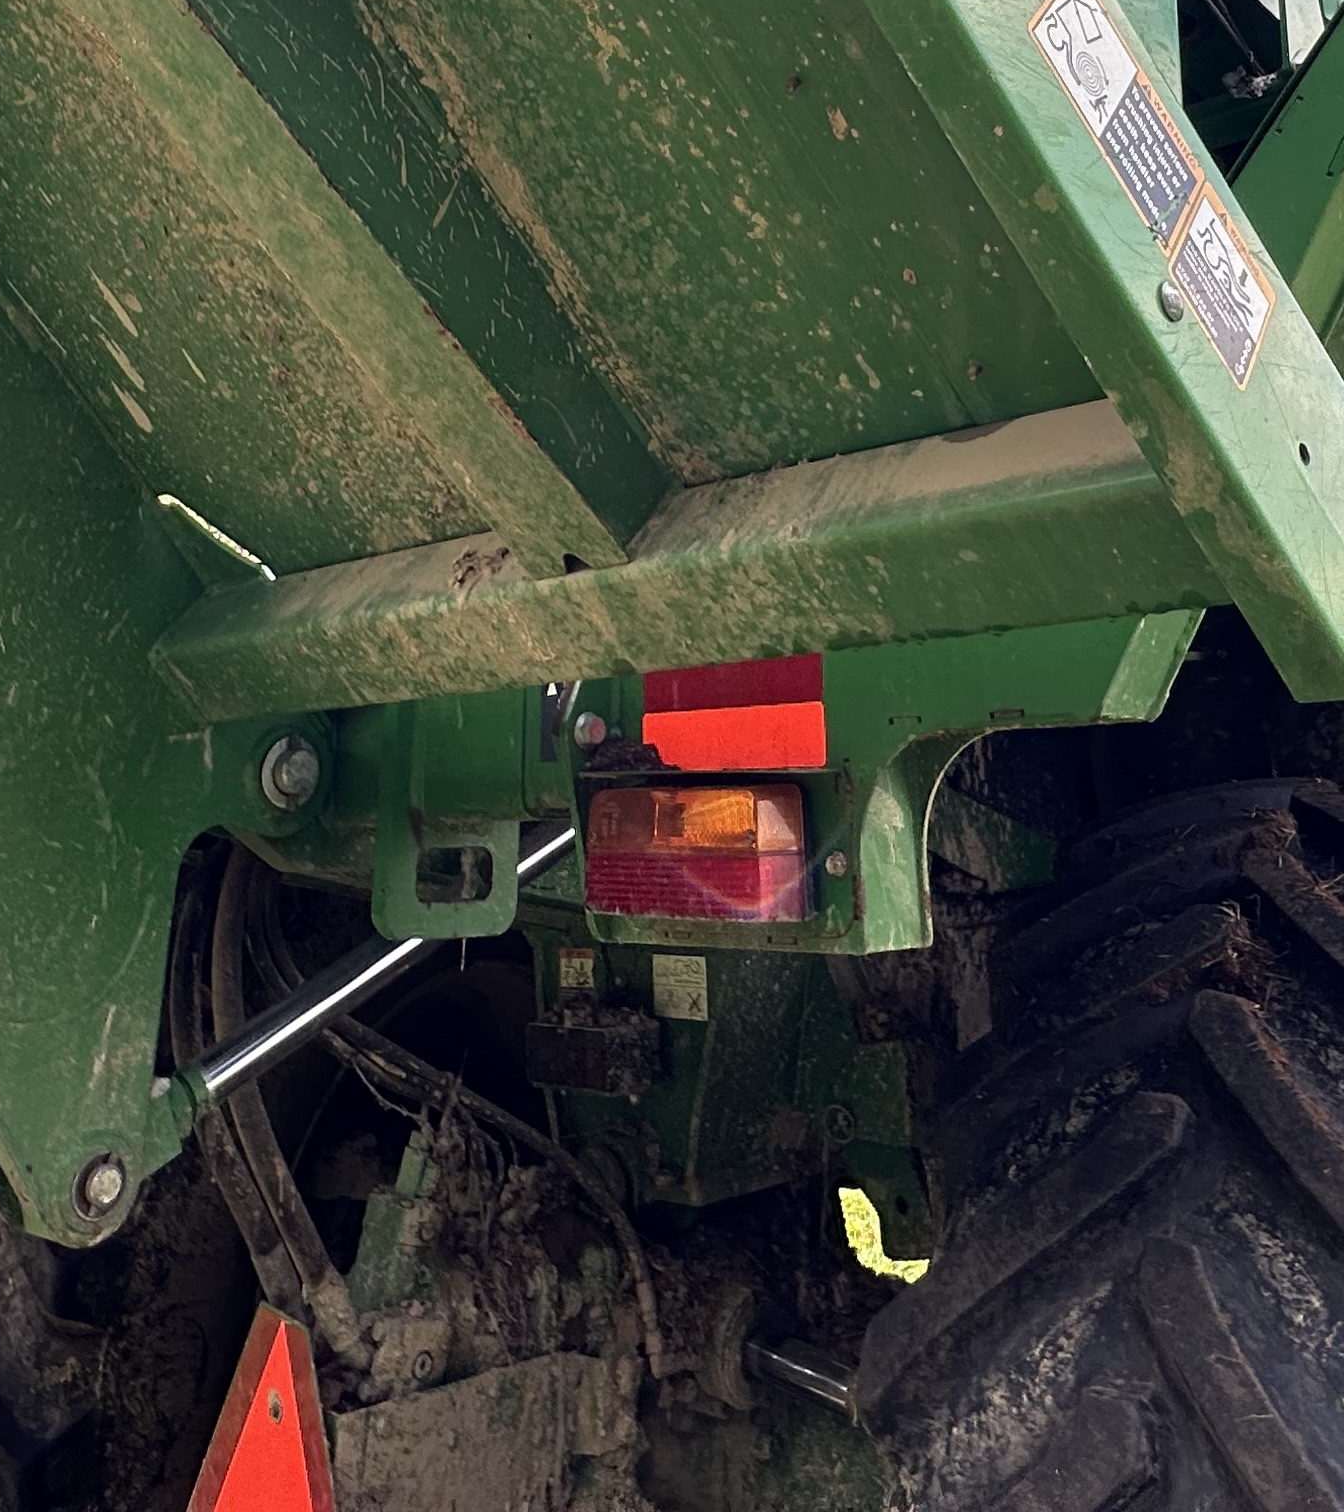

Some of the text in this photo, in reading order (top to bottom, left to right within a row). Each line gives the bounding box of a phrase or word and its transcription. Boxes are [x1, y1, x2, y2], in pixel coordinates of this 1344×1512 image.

[1105, 128, 1120, 154] and
[1118, 150, 1143, 192] rolling
[1111, 117, 1155, 190] from handler
[1117, 106, 1174, 202] death, keep away
[1123, 95, 1180, 190] crushing injury or
[1130, 84, 1188, 182] To prevent serious
[1152, 97, 1197, 172] WARNING
